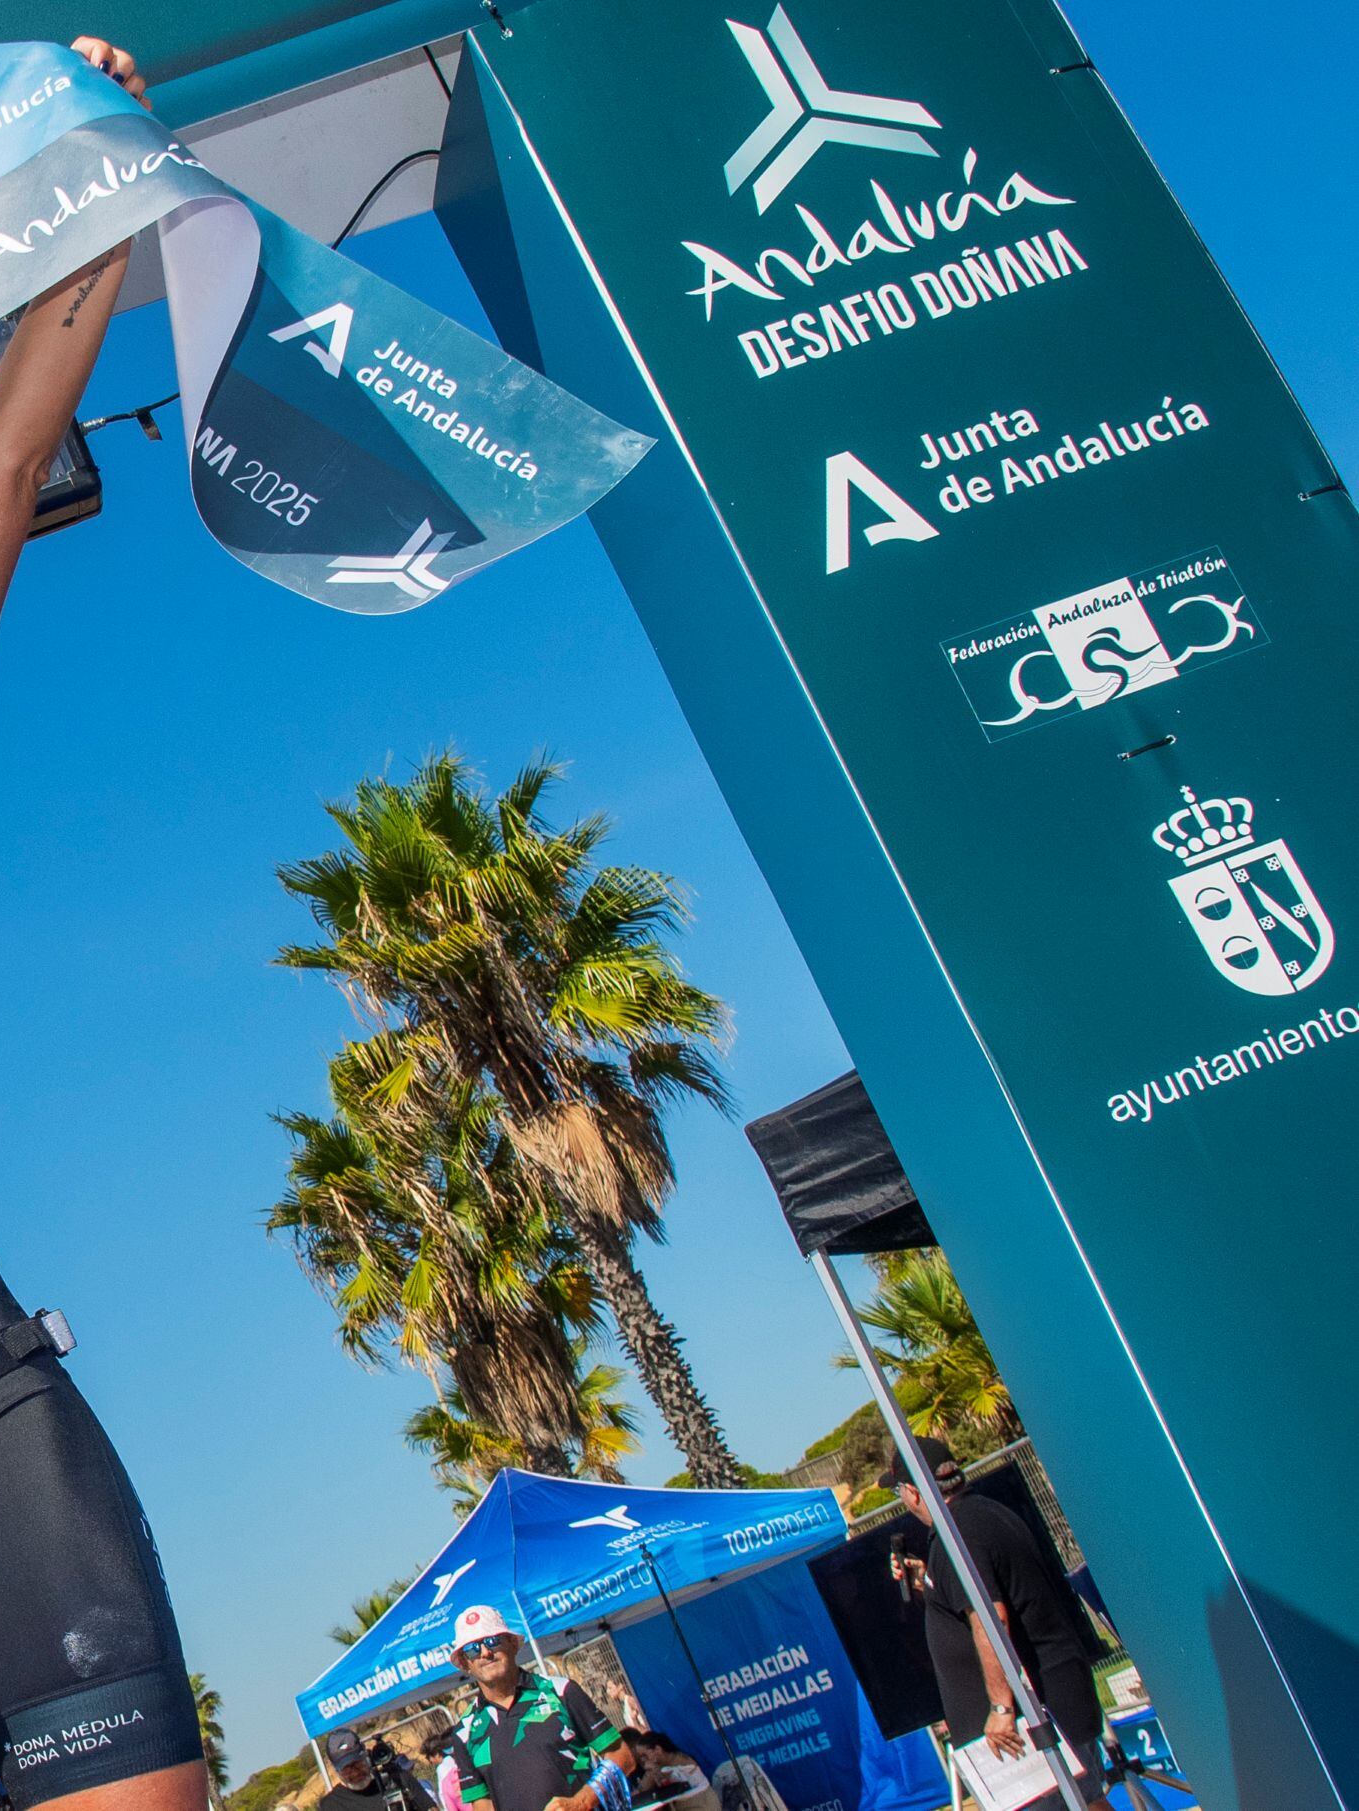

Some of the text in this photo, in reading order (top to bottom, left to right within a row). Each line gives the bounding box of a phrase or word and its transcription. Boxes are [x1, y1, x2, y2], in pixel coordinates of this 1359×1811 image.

[682, 147, 1076, 322] Andalucía
[738, 229, 1088, 378] DESAFIO DOÑANA
[374, 340, 459, 400] Junta
[357, 366, 540, 481] de Andalucía
[920, 408, 1040, 470] Junta
[938, 396, 1210, 513] de Andalucía
[232, 460, 319, 526] 2025
[948, 556, 1227, 664] Federación Andaluza de Triatlón
[1107, 1002, 1359, 1123] ayuntamiento
[723, 1503, 831, 1556] TODOTROFEO
[537, 1559, 653, 1618] TODOTROFEO
[317, 1665, 400, 1720] GRABACIÓN
[397, 1656, 421, 1681] DE
[703, 1644, 810, 1700] GRABACIÓN
[733, 1669, 834, 1722] MEDALLAS
[12, 1708, 145, 1755] DONA MÉDULA
[17, 1734, 112, 1770] DONA VIDA
[735, 1708, 821, 1750] ENGRAVING
[768, 1731, 832, 1767] MEDALS
[1137, 1728, 1157, 1756] 2
